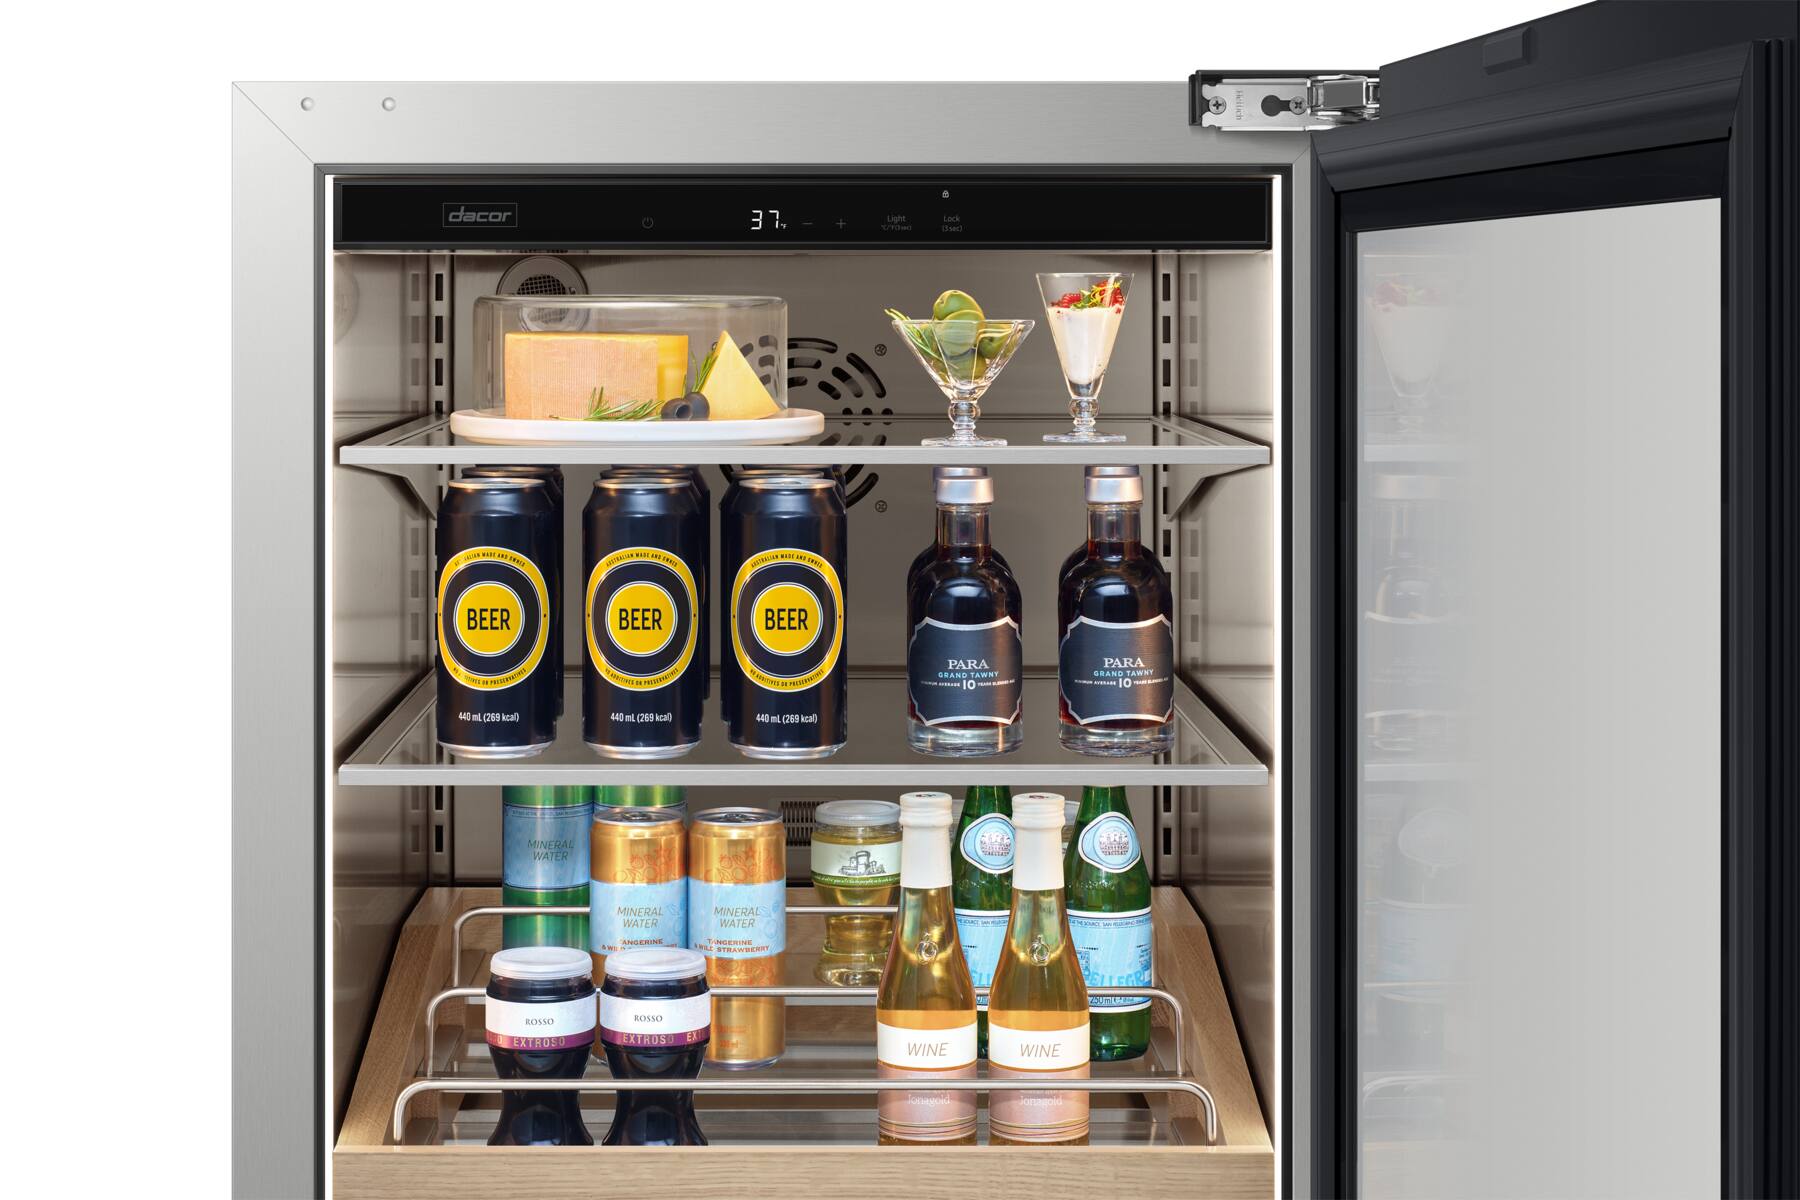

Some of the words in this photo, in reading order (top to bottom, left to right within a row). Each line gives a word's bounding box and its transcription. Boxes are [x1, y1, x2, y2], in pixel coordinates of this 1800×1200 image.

[448, 206, 512, 222] dacor
[751, 210, 779, 229] 37
[887, 215, 906, 223] Light
[467, 608, 511, 630] BEER
[619, 608, 662, 630] BEER
[765, 608, 808, 630] BEER
[947, 658, 990, 670] PARA
[1103, 657, 1146, 668] PARA
[938, 671, 968, 679] GRAND
[970, 671, 999, 679] TAWNY
[1126, 669, 1154, 677] TAWNY
[962, 680, 976, 690] 10
[1118, 678, 1132, 689] 10
[459, 712, 471, 721] 440
[472, 713, 482, 722] mL
[483, 712, 501, 723] (269
[502, 712, 520, 723] kcal)
[610, 712, 624, 722] 440
[625, 713, 636, 722] mL
[637, 712, 655, 723] (269
[655, 712, 673, 723] kcal)
[756, 713, 770, 723] 440
[770, 714, 782, 723] mL
[782, 713, 800, 724] (269
[800, 713, 818, 724] kcal)
[527, 840, 574, 850] MINERAL
[533, 851, 569, 861] WATER
[617, 906, 664, 917] MINERAL
[713, 906, 761, 917] MINERAL
[623, 918, 659, 929] WATER
[720, 918, 756, 929] WATER
[707, 938, 753, 946] TANGERINE
[716, 945, 770, 953] STRAWBERRY
[525, 1018, 554, 1026] ROSSO
[634, 1014, 663, 1023] ROSSO
[513, 1036, 566, 1048] EXTROSO
[623, 1032, 674, 1045] EXTROSO
[908, 1042, 949, 1057] WINE
[1020, 1043, 1061, 1058] WINE
[907, 1094, 951, 1106] Jonagold
[1019, 1095, 1063, 1107] Jonagold
